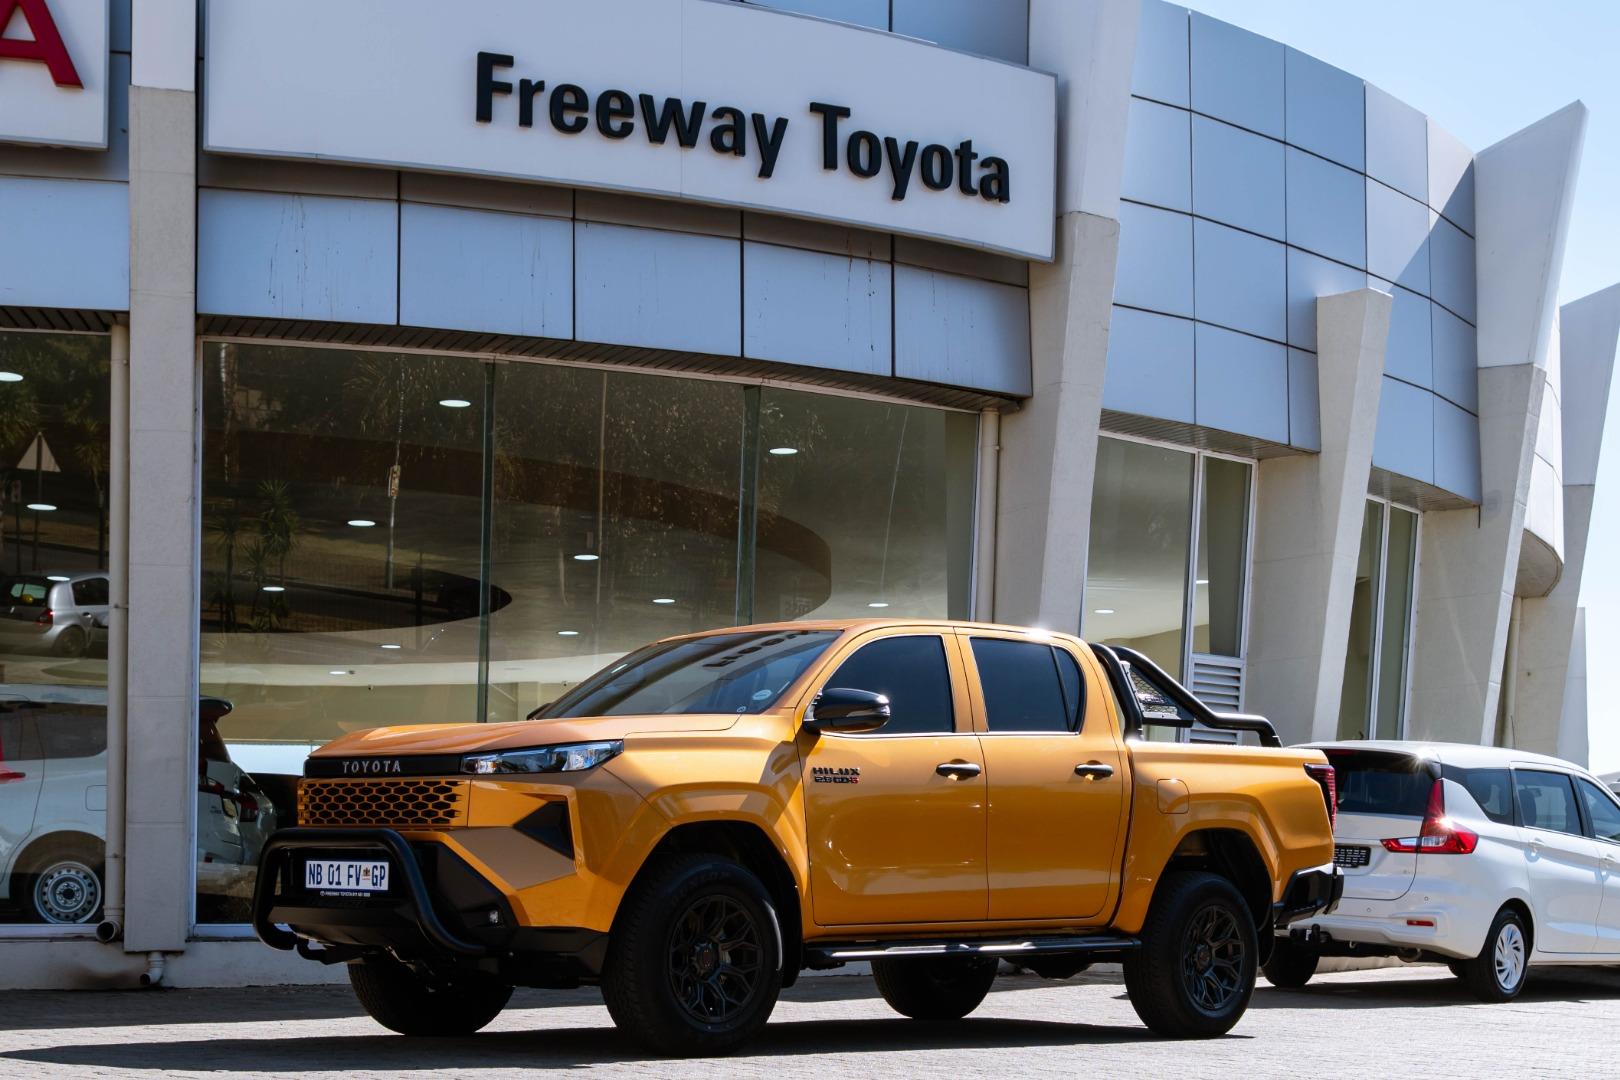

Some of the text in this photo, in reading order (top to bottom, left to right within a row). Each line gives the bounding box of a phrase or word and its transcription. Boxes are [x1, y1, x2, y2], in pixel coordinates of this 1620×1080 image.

[476, 51, 1010, 204] Freeway Toyota
[342, 760, 401, 774] TOYOTA
[812, 767, 860, 776] HILUX
[308, 863, 386, 887] NB 01 FV GP
